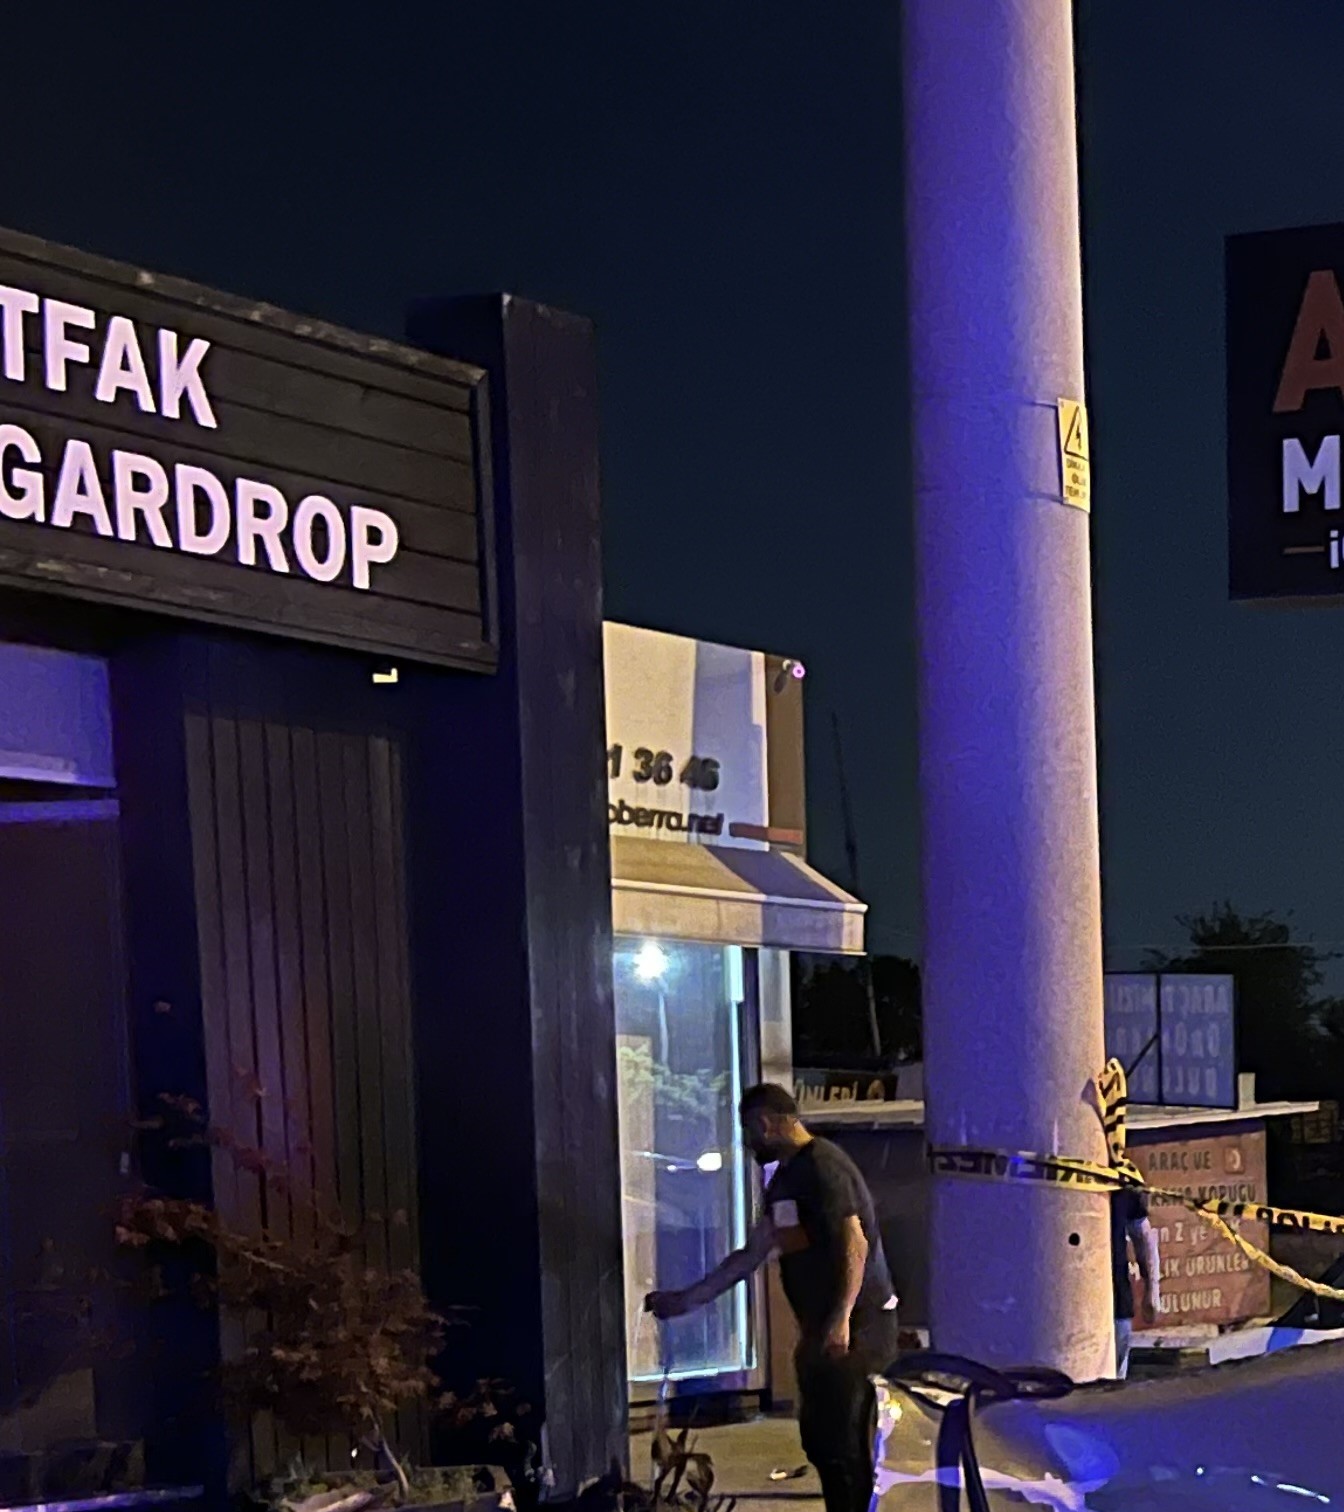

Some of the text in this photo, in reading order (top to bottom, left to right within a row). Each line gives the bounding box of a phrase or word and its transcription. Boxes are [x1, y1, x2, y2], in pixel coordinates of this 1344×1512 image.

[0, 284, 218, 429] TFAK
[0, 424, 400, 590] GARDROP
[632, 746, 674, 786] 36
